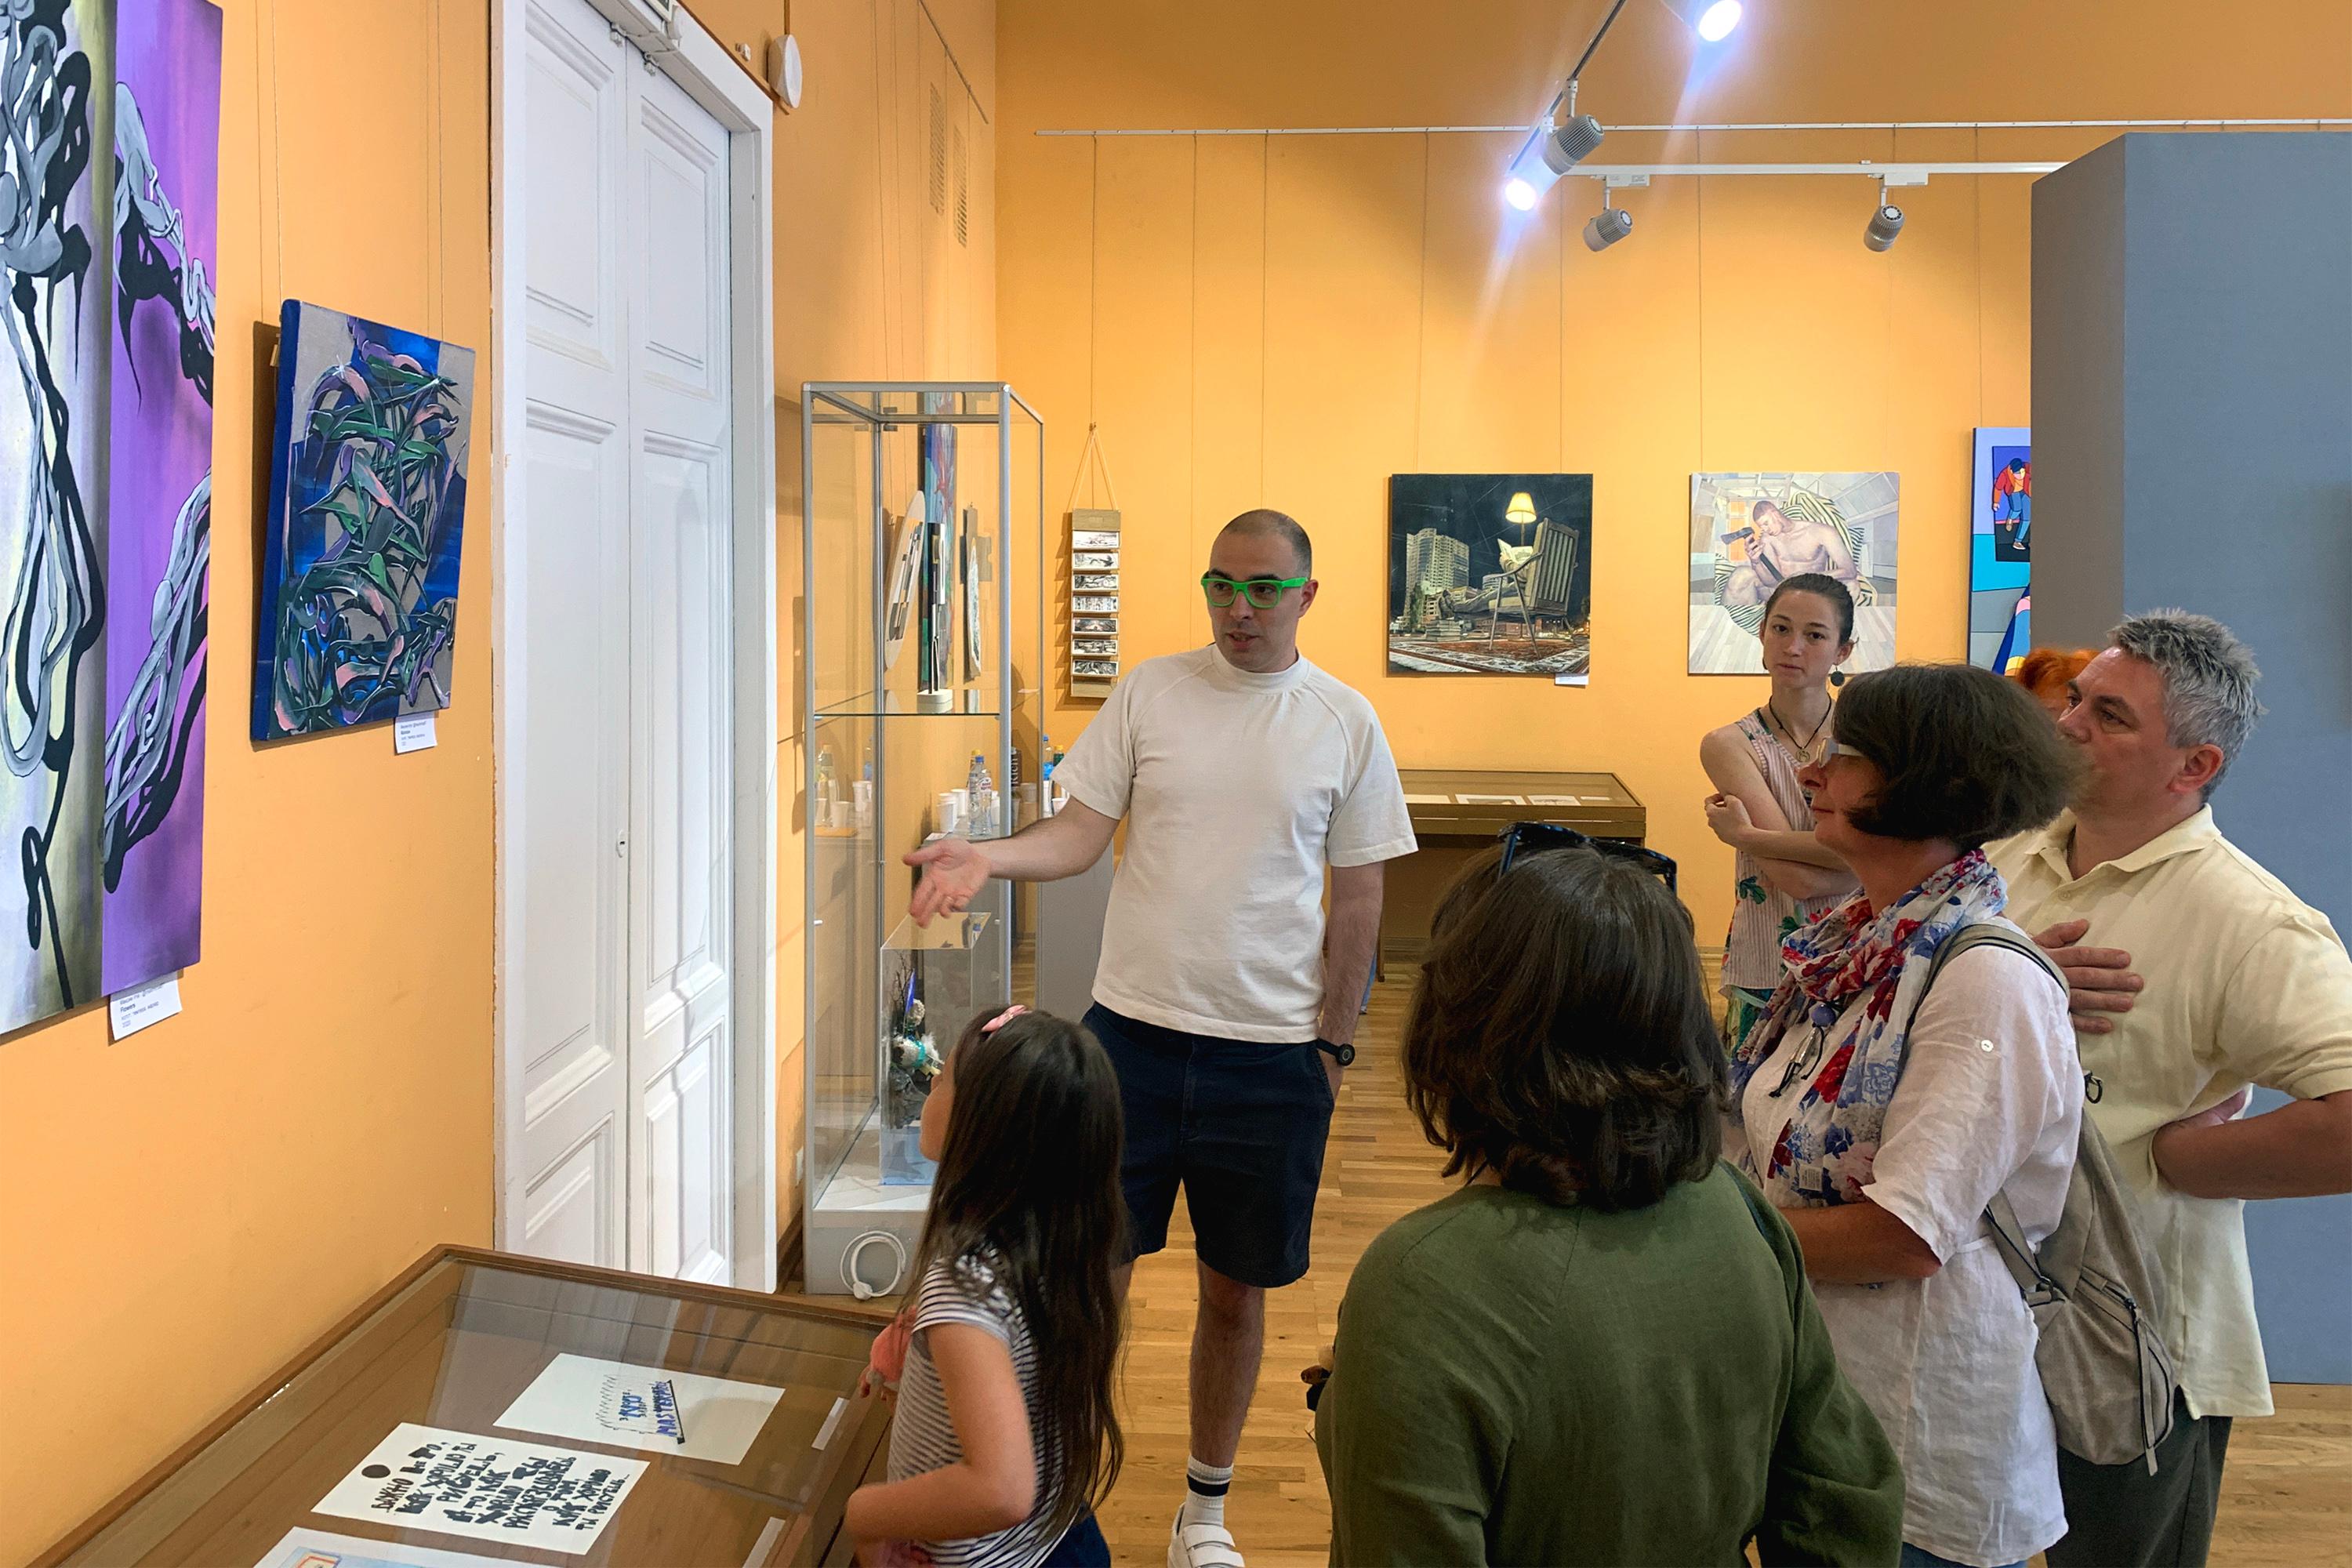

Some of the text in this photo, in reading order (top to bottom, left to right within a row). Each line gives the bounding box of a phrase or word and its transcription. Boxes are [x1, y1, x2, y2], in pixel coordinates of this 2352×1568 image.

[452, 1443, 477, 1451] ТЫ
[512, 1457, 549, 1480] ТЫ
[475, 1469, 511, 1493] КАК
[371, 1478, 414, 1513] ВАЖНО
[552, 1468, 612, 1526] КАК ХОРОШО
[575, 1517, 599, 1530] ТЫ
